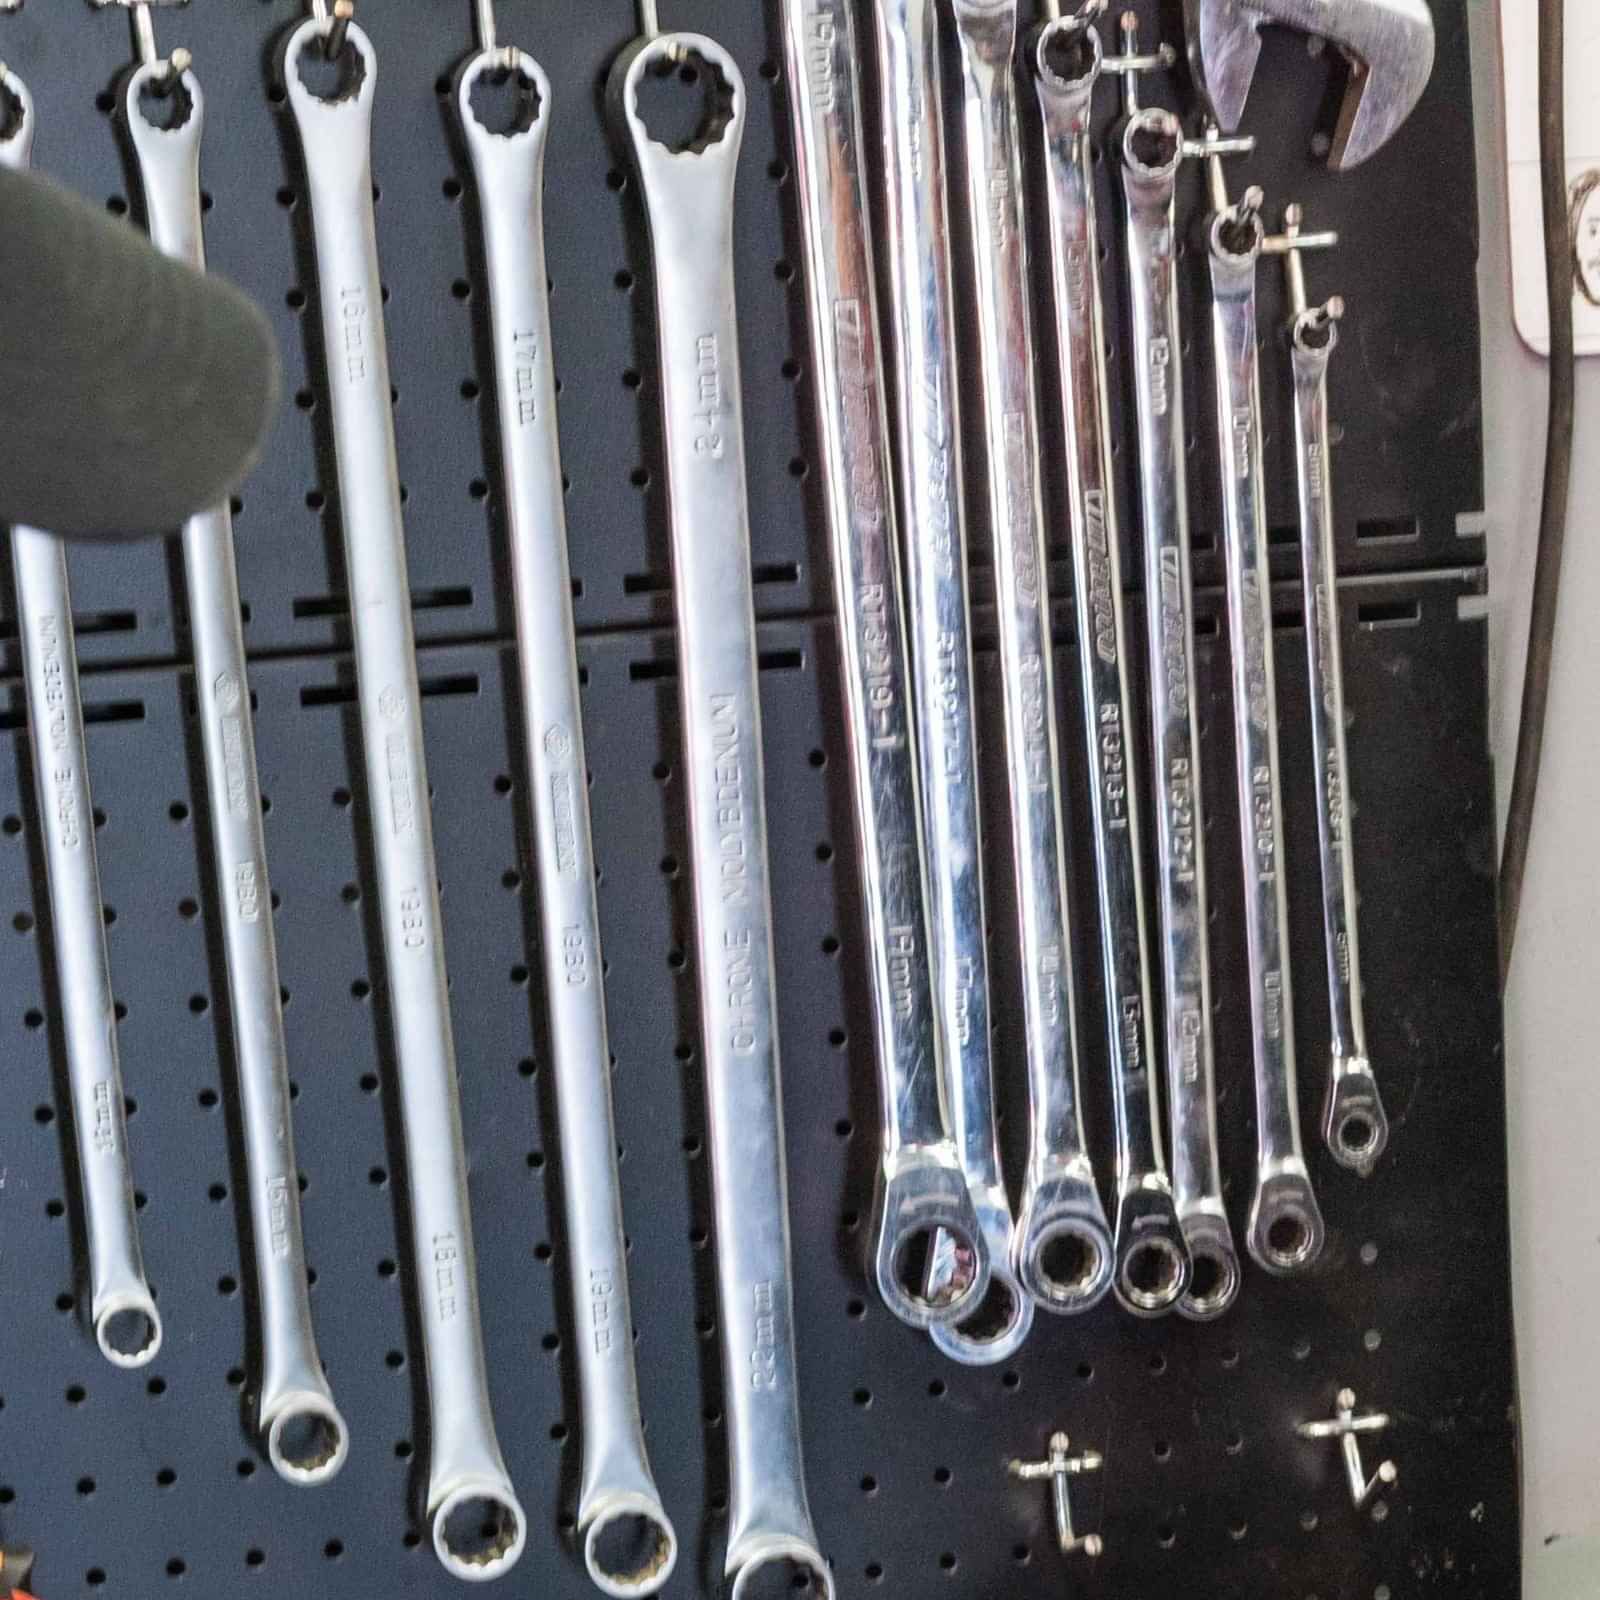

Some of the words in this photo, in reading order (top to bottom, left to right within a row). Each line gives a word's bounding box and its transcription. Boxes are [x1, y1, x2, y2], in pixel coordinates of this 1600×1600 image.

[512, 328, 542, 426] 17mm
[686, 333, 724, 459] 24mm
[1148, 336, 1171, 415] 12mm
[857, 583, 903, 751] RT3219-1
[710, 694, 748, 904] MOLYBDENUM
[1099, 703, 1127, 828] RT3213-1
[1169, 757, 1193, 881] RT3212-1
[723, 930, 757, 1053] CHROME
[1181, 1009, 1202, 1083] 12mm
[744, 1279, 778, 1390] 22mm
